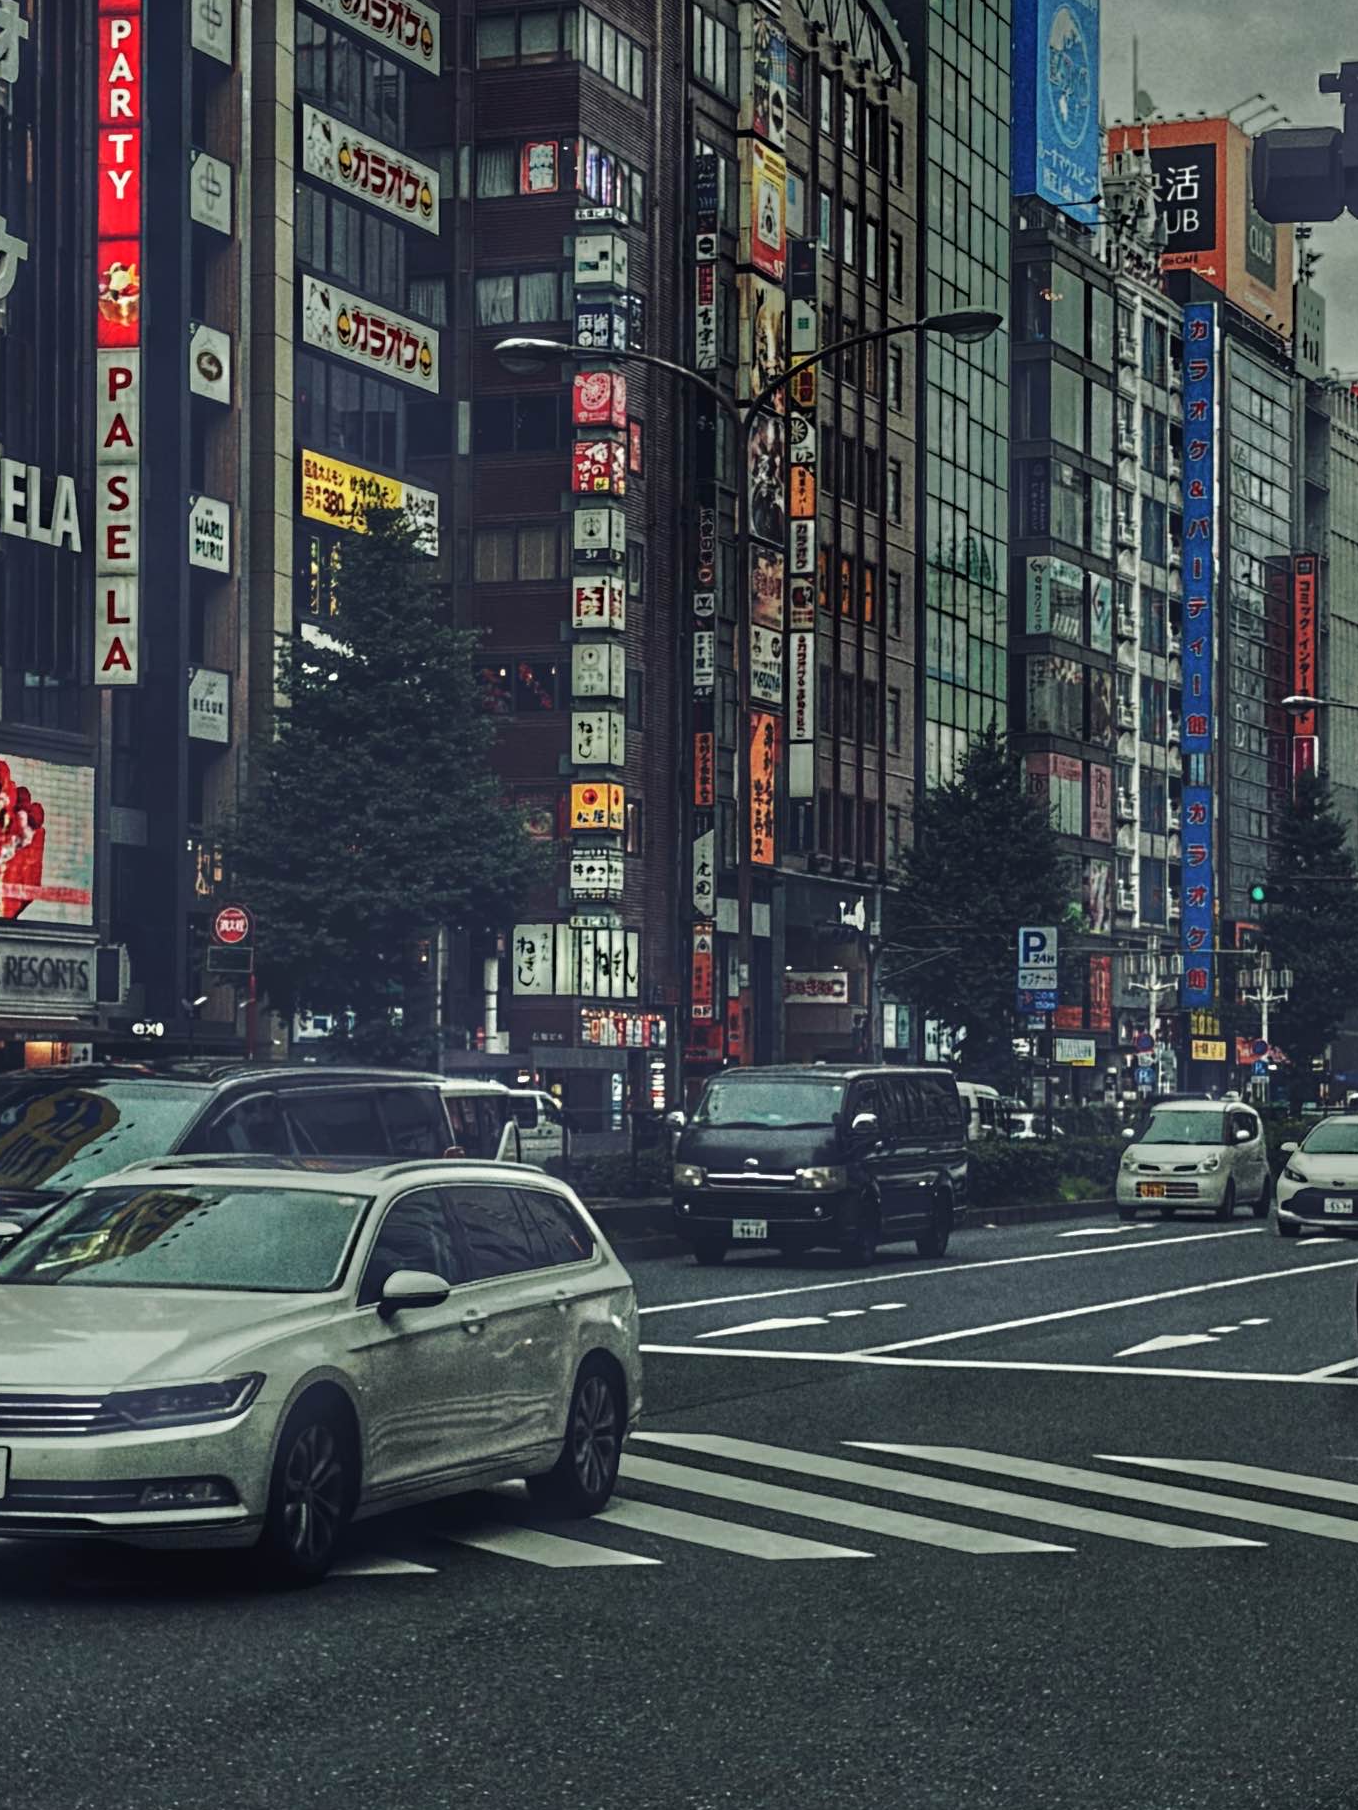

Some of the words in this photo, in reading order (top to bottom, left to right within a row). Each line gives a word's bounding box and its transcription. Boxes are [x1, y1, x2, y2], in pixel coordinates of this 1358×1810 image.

[106, 17, 137, 201] PARTY
[350, 142, 423, 216] カラオケ
[349, 309, 420, 372] カラオケ
[102, 365, 136, 674] PASELA
[1297, 580, 1312, 724] コミック・インタート
[6, 953, 91, 993] RESORTS
[1021, 932, 1047, 965] P
